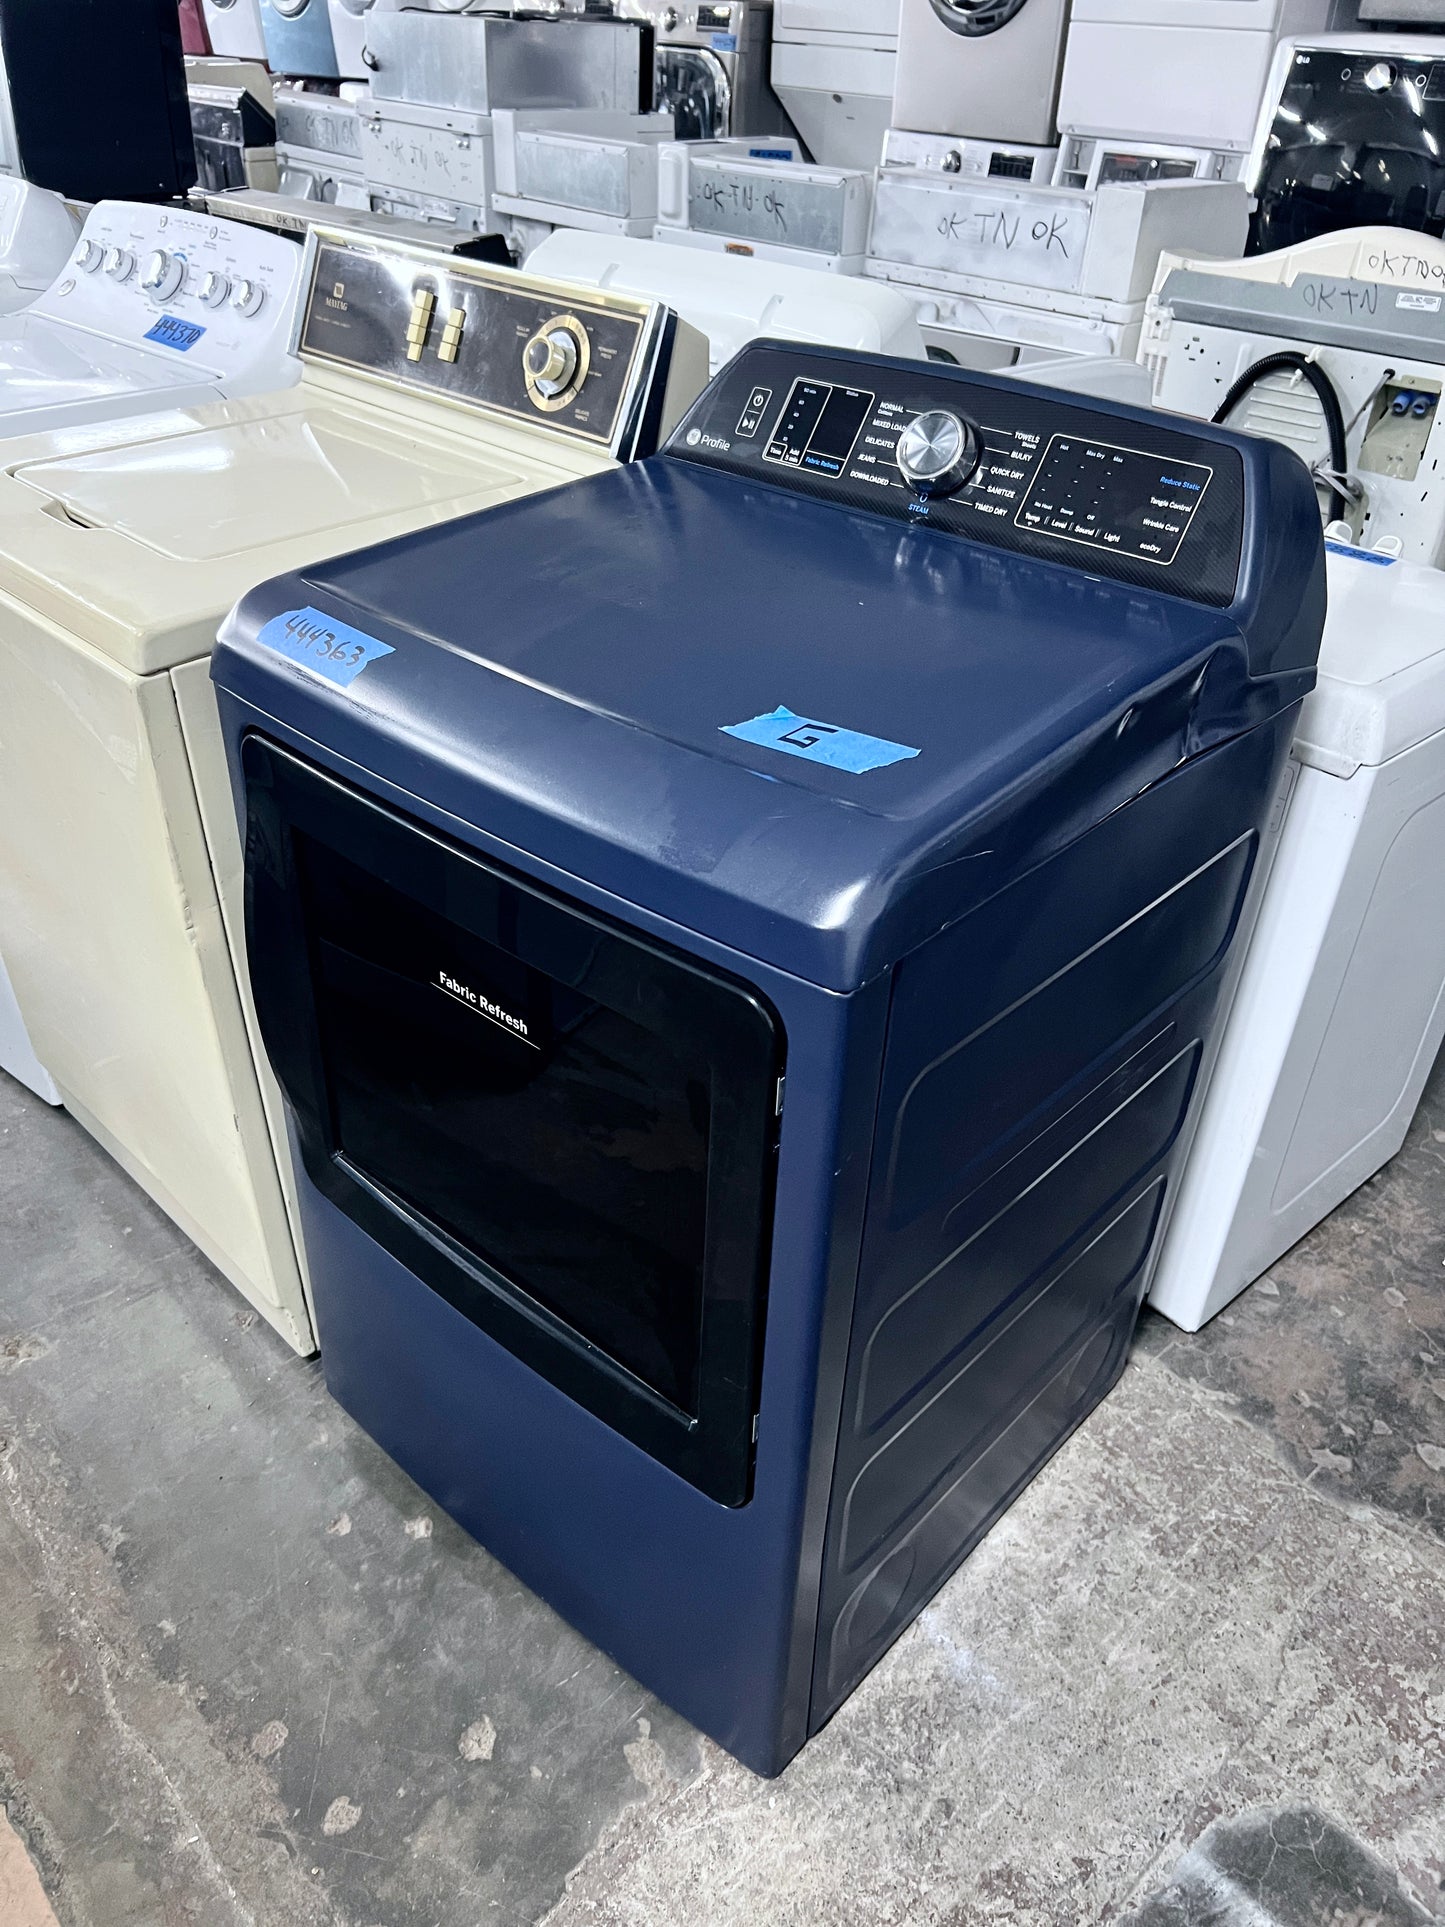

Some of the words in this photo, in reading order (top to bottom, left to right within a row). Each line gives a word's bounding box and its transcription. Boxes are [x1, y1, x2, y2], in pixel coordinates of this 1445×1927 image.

[937, 212, 967, 239] OK
[974, 211, 1020, 249] TN
[1032, 212, 1069, 258] OK
[326, 297, 348, 311] MAYTAG
[1303, 283, 1336, 312] OK
[154, 321, 201, 344] 444370
[879, 401, 904, 413] NORMAL
[872, 418, 891, 429] MIXED
[701, 434, 731, 451] Profile
[864, 436, 896, 449] DELICATES
[1014, 431, 1040, 444] TOWELS
[857, 453, 877, 464] JEANS
[1010, 450, 1033, 462] BULKY
[805, 456, 820, 466] Fabric
[820, 460, 839, 471] Refresh
[849, 470, 890, 486] DOWNLOADED
[990, 466, 1011, 478] QUICK
[1010, 469, 1025, 480] DRY
[1160, 476, 1182, 487] Reduce
[1182, 481, 1201, 491] Static
[986, 485, 1016, 499] SANITIZE
[908, 503, 930, 515] STEAM
[974, 502, 994, 513] TIMED
[994, 507, 1008, 517] DRY
[1150, 496, 1169, 508] Tangle
[1169, 501, 1193, 513] Control
[1051, 518, 1068, 529] Level
[1074, 525, 1095, 536] Sound
[1142, 518, 1165, 530] Wrinkle
[1165, 523, 1180, 533] Care
[1103, 532, 1121, 543] Light
[1139, 543, 1162, 554] ecoDry
[285, 614, 366, 667] 444363
[439, 970, 477, 1004] Fabric
[479, 994, 528, 1035] Refresh
